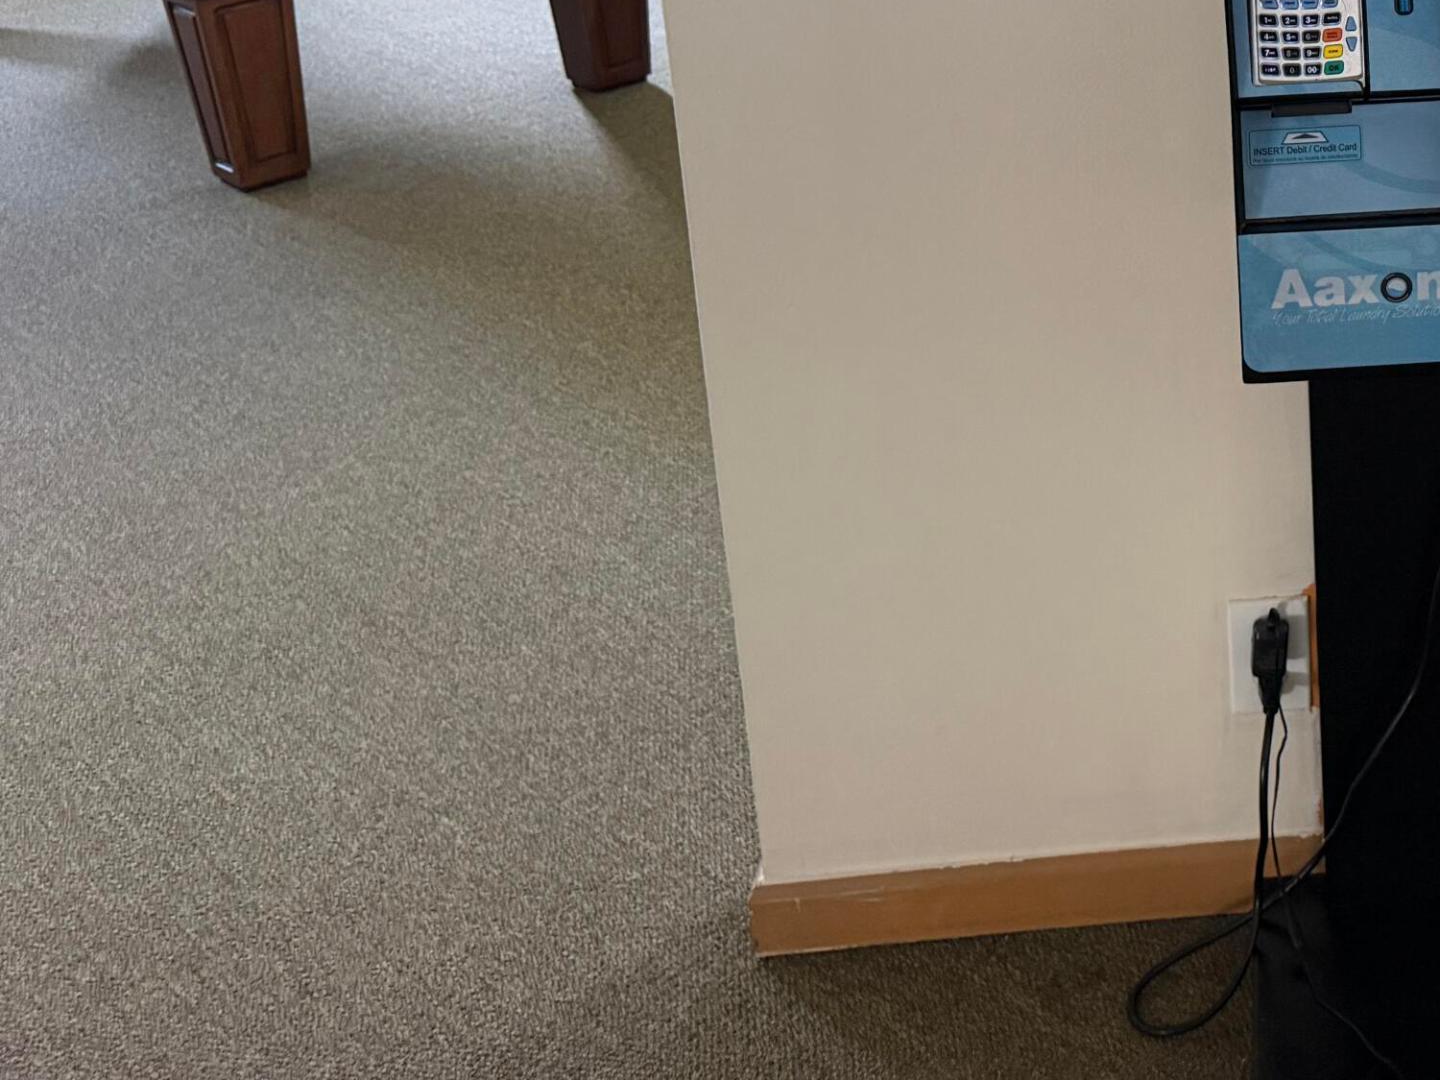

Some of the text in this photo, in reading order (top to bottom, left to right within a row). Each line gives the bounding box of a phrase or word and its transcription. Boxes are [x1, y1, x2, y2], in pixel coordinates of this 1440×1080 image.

[1253, 146, 1285, 156] INSERT
[1286, 145, 1307, 155] Debit
[1313, 143, 1337, 153] Credit
[1338, 142, 1357, 152] Card
[1271, 311, 1304, 326] Your
[1307, 308, 1339, 323] Total
[1341, 306, 1391, 323] Laundry
